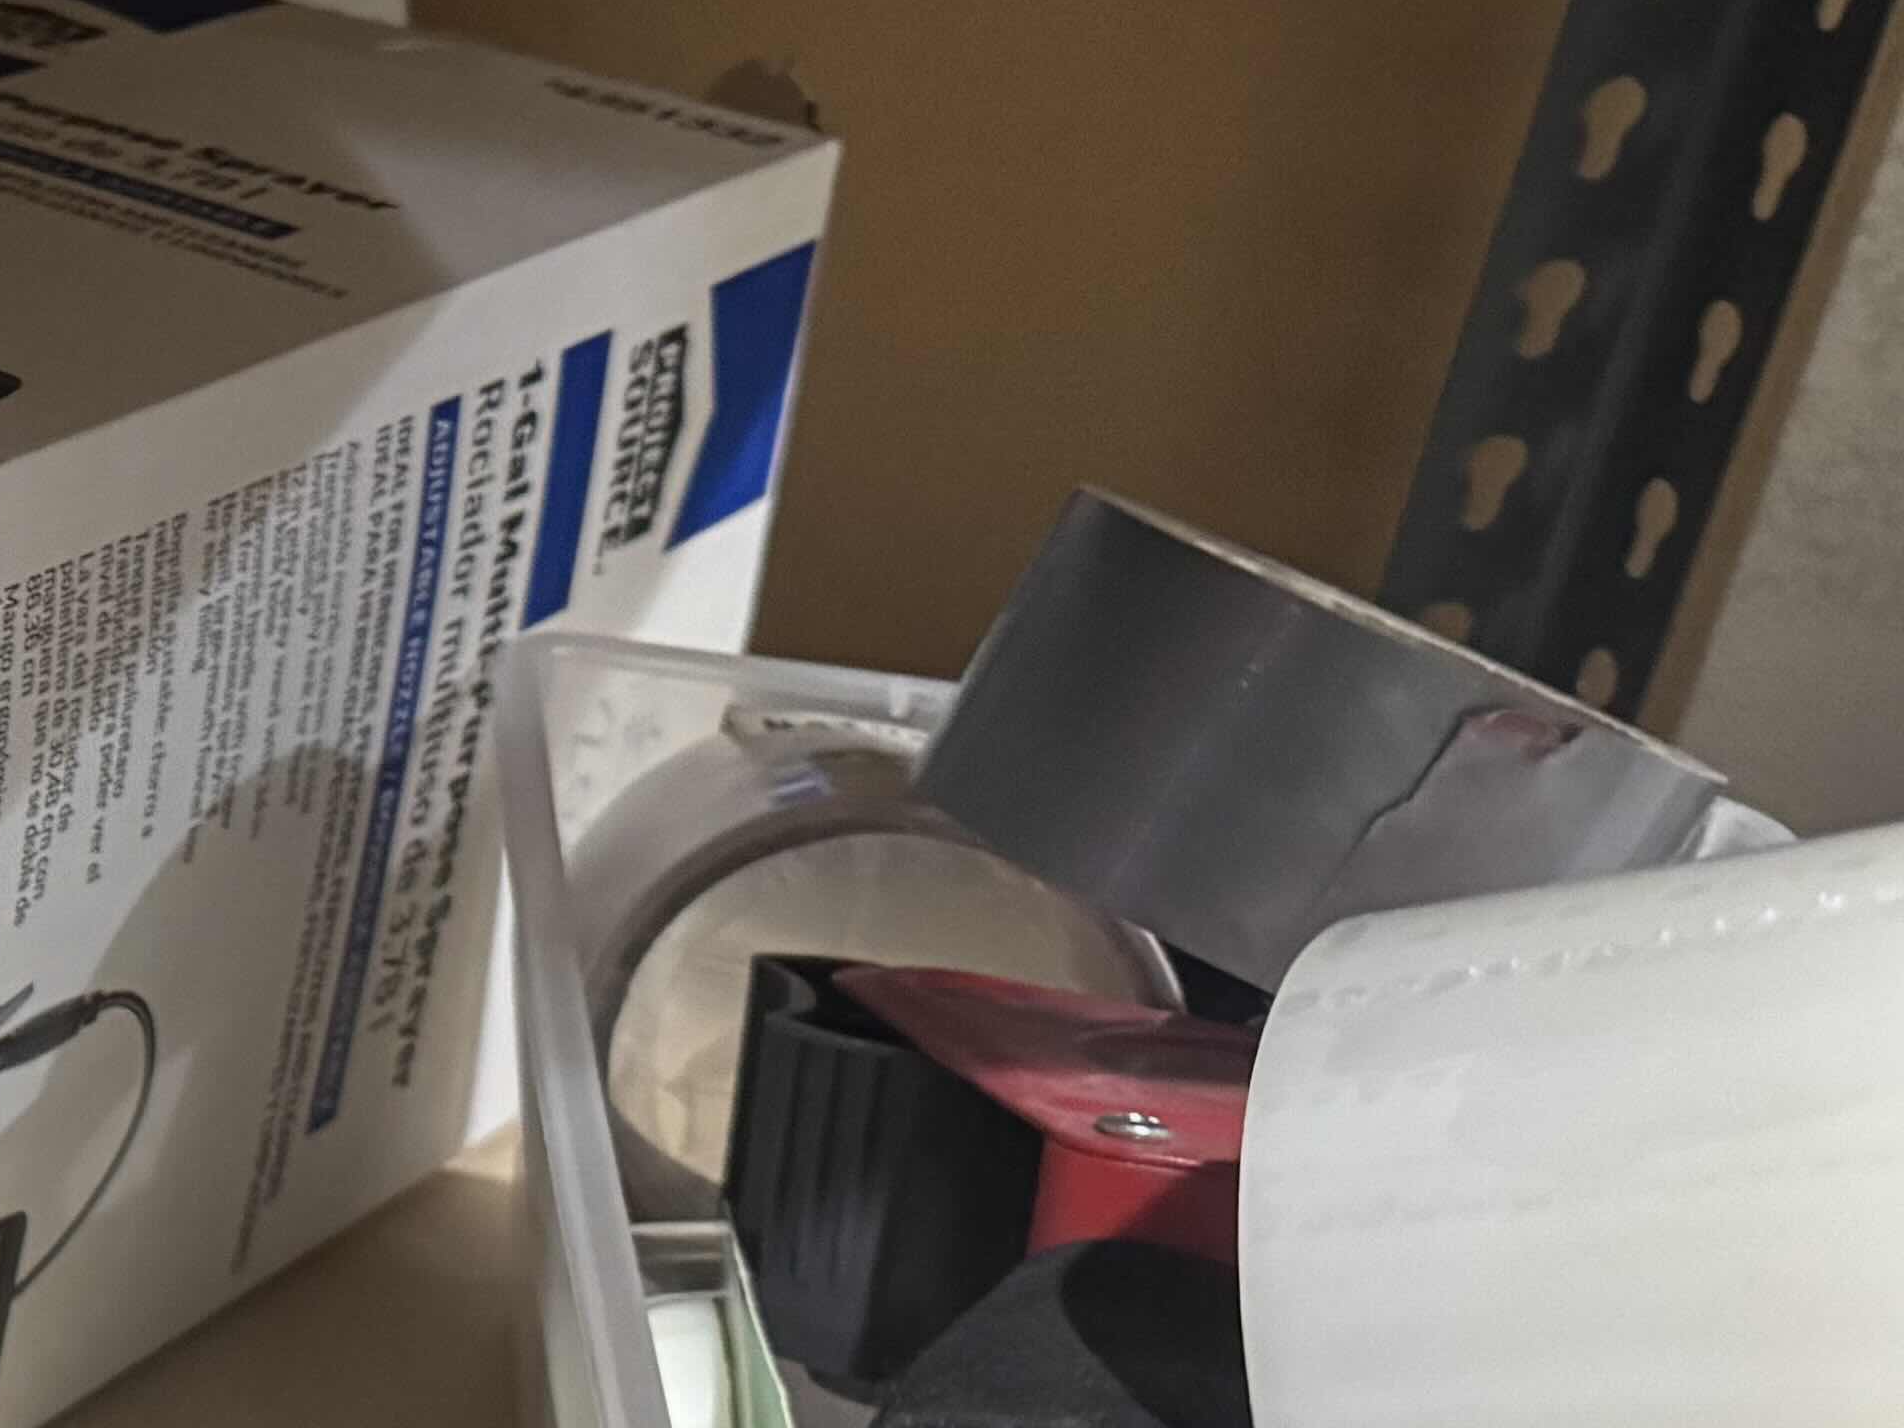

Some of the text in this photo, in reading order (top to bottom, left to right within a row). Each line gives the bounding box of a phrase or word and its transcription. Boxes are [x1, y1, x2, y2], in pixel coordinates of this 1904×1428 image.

[502, 358, 547, 503] 1-Gal
[595, 338, 654, 559] SOURCE
[450, 377, 506, 604] Rociador
[408, 415, 453, 633] ADJUSTABLE
[93, 607, 112, 646] de
[18, 654, 37, 701] cm
[71, 647, 90, 693] del
[29, 698, 50, 751] que
[50, 692, 70, 733] de
[102, 679, 121, 739] para
[430, 507, 525, 893] Multi-Purpose
[28, 750, 46, 788] no
[95, 739, 117, 811] poder
[37, 810, 55, 855] cm
[32, 852, 51, 903] con
[397, 831, 433, 896] de
